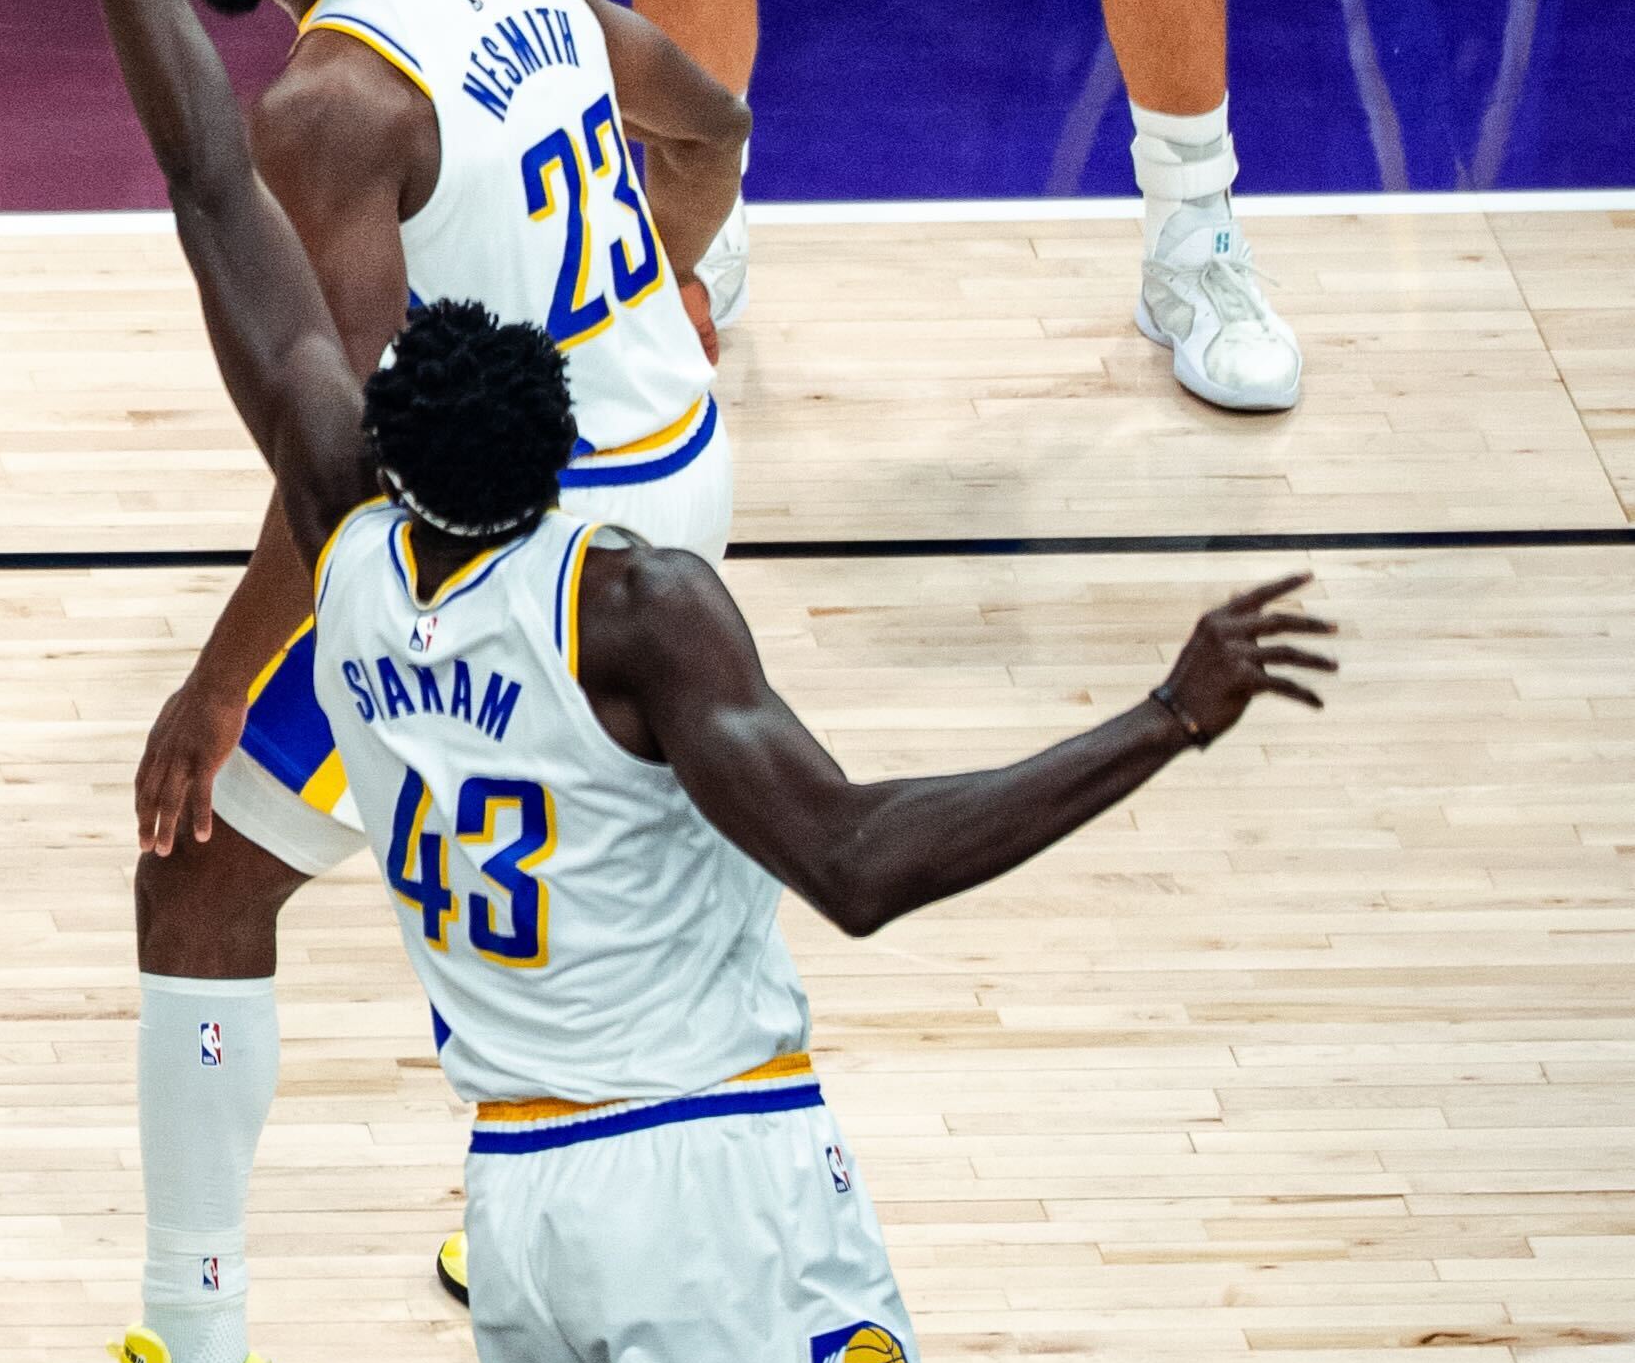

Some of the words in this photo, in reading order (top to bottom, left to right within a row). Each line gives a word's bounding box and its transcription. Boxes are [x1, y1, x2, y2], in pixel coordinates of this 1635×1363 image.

[462, 6, 580, 124] NESMITH
[521, 92, 664, 352] 23
[386, 764, 561, 969] 43
